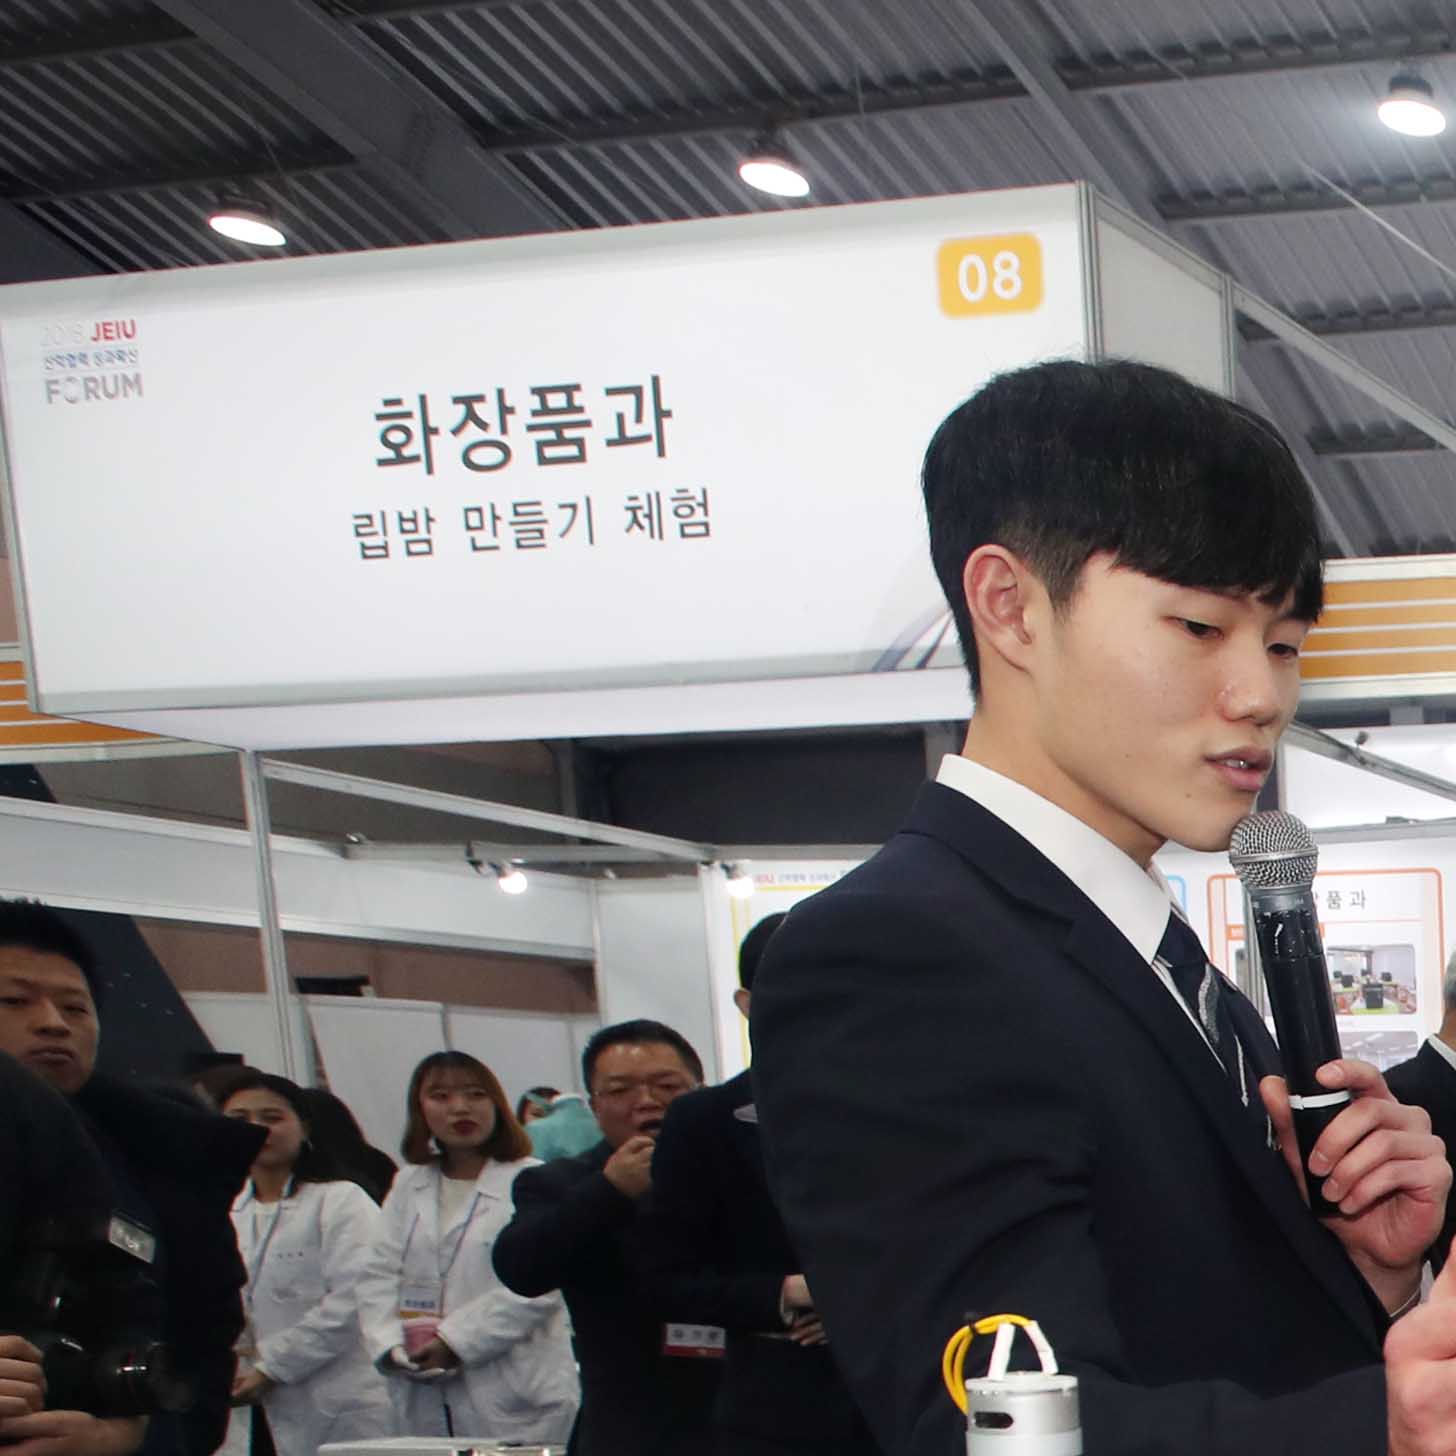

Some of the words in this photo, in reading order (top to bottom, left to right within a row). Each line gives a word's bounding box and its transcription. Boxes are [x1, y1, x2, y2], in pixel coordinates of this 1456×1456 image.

[957, 249, 1024, 305] 08
[91, 318, 137, 343] JEIU
[45, 372, 144, 404] FORUM
[374, 374, 673, 476] 화장품과
[351, 507, 436, 560] 립밤
[463, 495, 595, 552] 만들기
[624, 487, 712, 541] 체험
